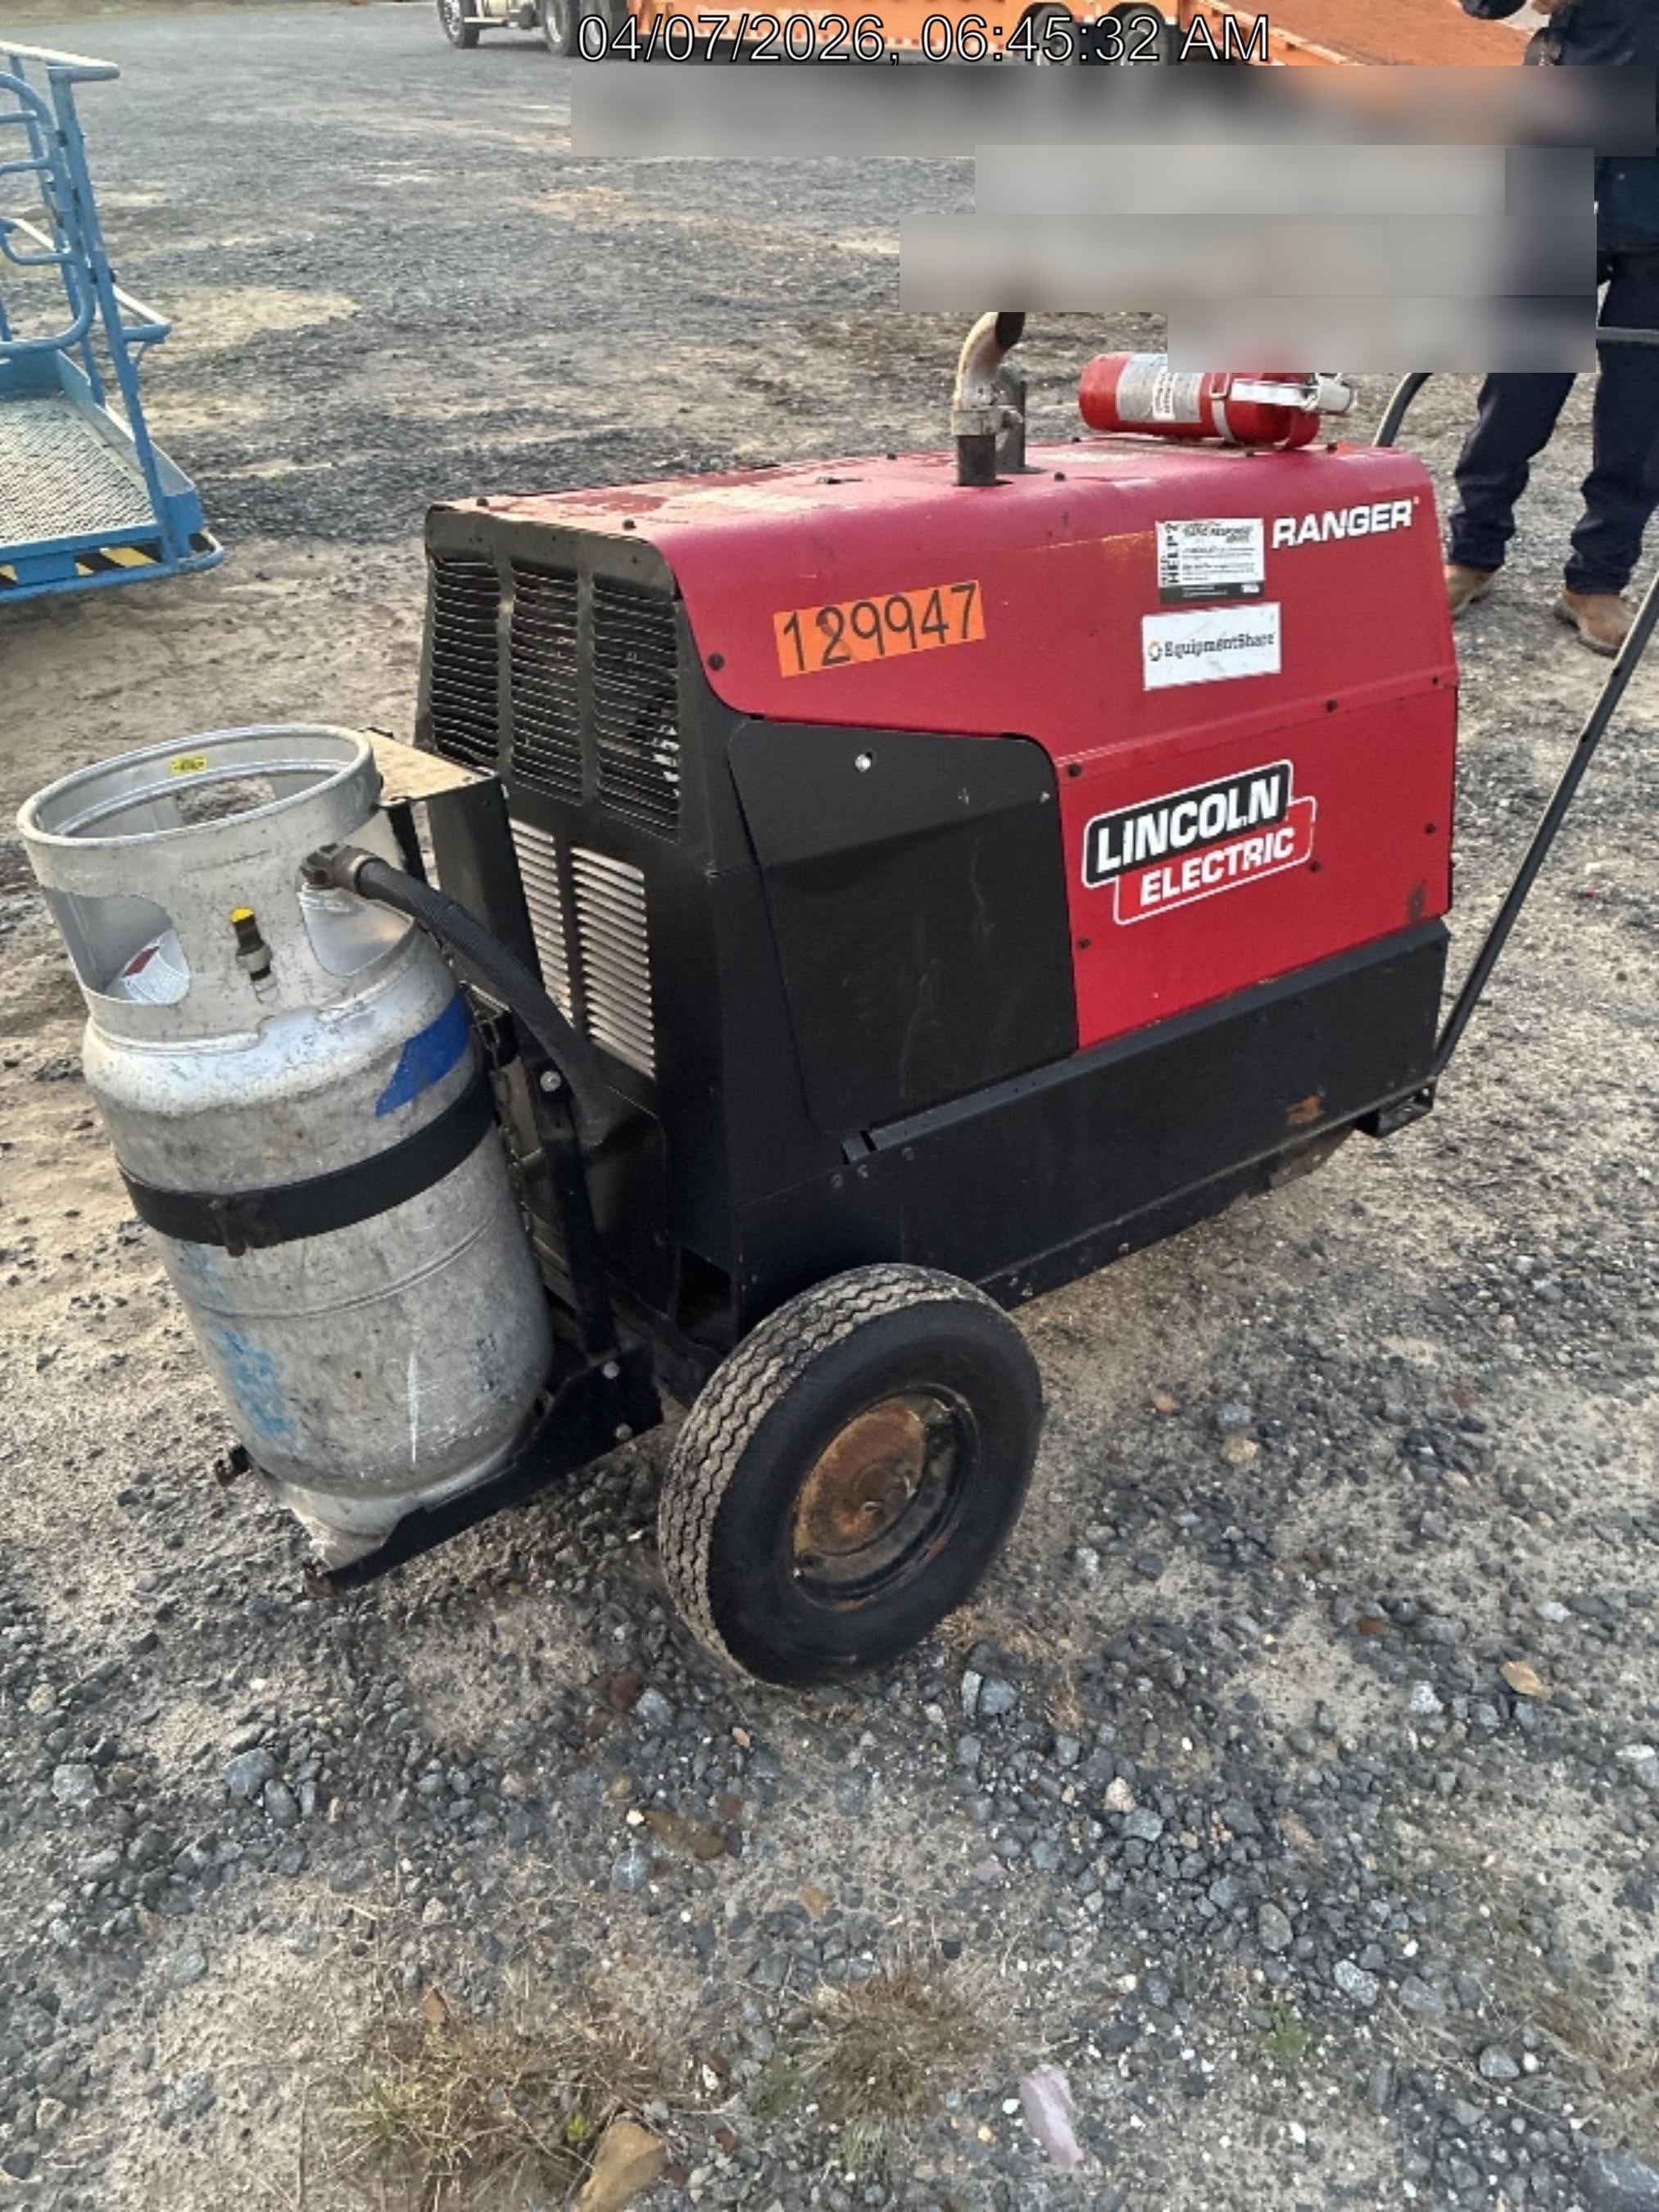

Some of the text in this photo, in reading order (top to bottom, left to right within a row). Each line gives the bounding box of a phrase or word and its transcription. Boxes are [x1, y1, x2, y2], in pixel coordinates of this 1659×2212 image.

[1271, 499, 1413, 550] RANGER
[783, 582, 977, 672] 129947
[1164, 631, 1275, 660] EquipmentShare
[1096, 774, 1281, 874] LINCOLN
[1140, 827, 1295, 906] ELECTRIC
